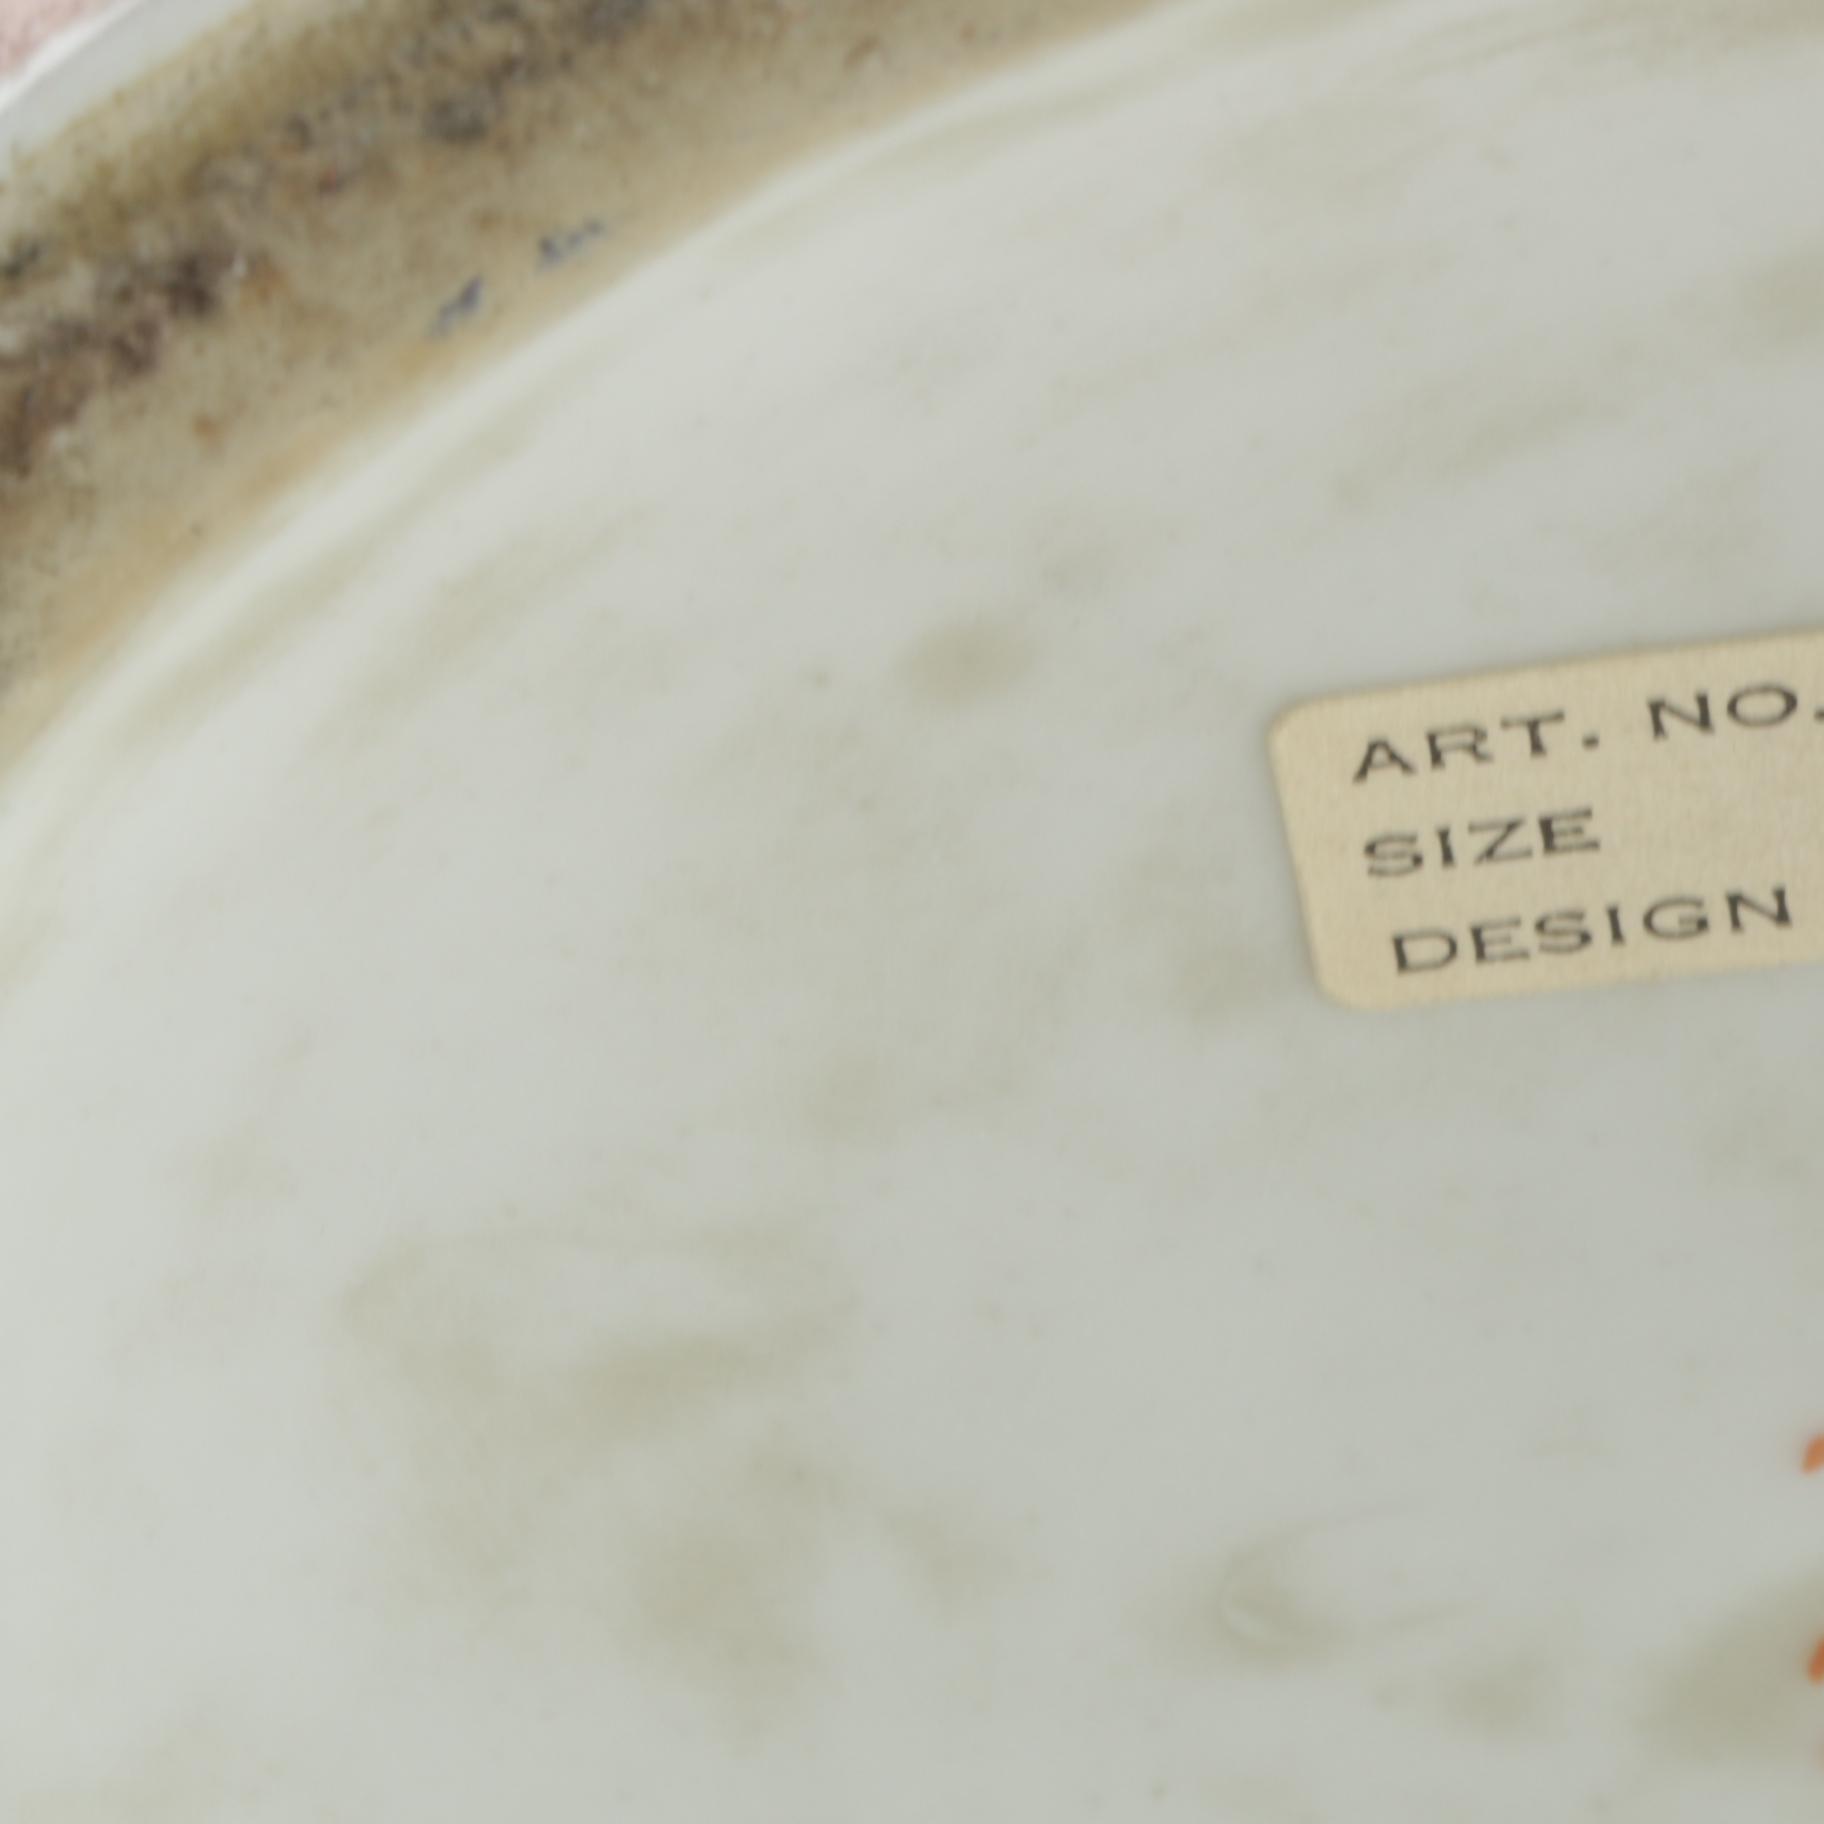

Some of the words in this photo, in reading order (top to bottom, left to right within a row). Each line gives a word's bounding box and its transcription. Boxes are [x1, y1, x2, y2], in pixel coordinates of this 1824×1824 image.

[1352, 712, 1603, 784] ART.
[1362, 809, 1602, 878] SIZE
[1391, 887, 1794, 974] DESIGN
